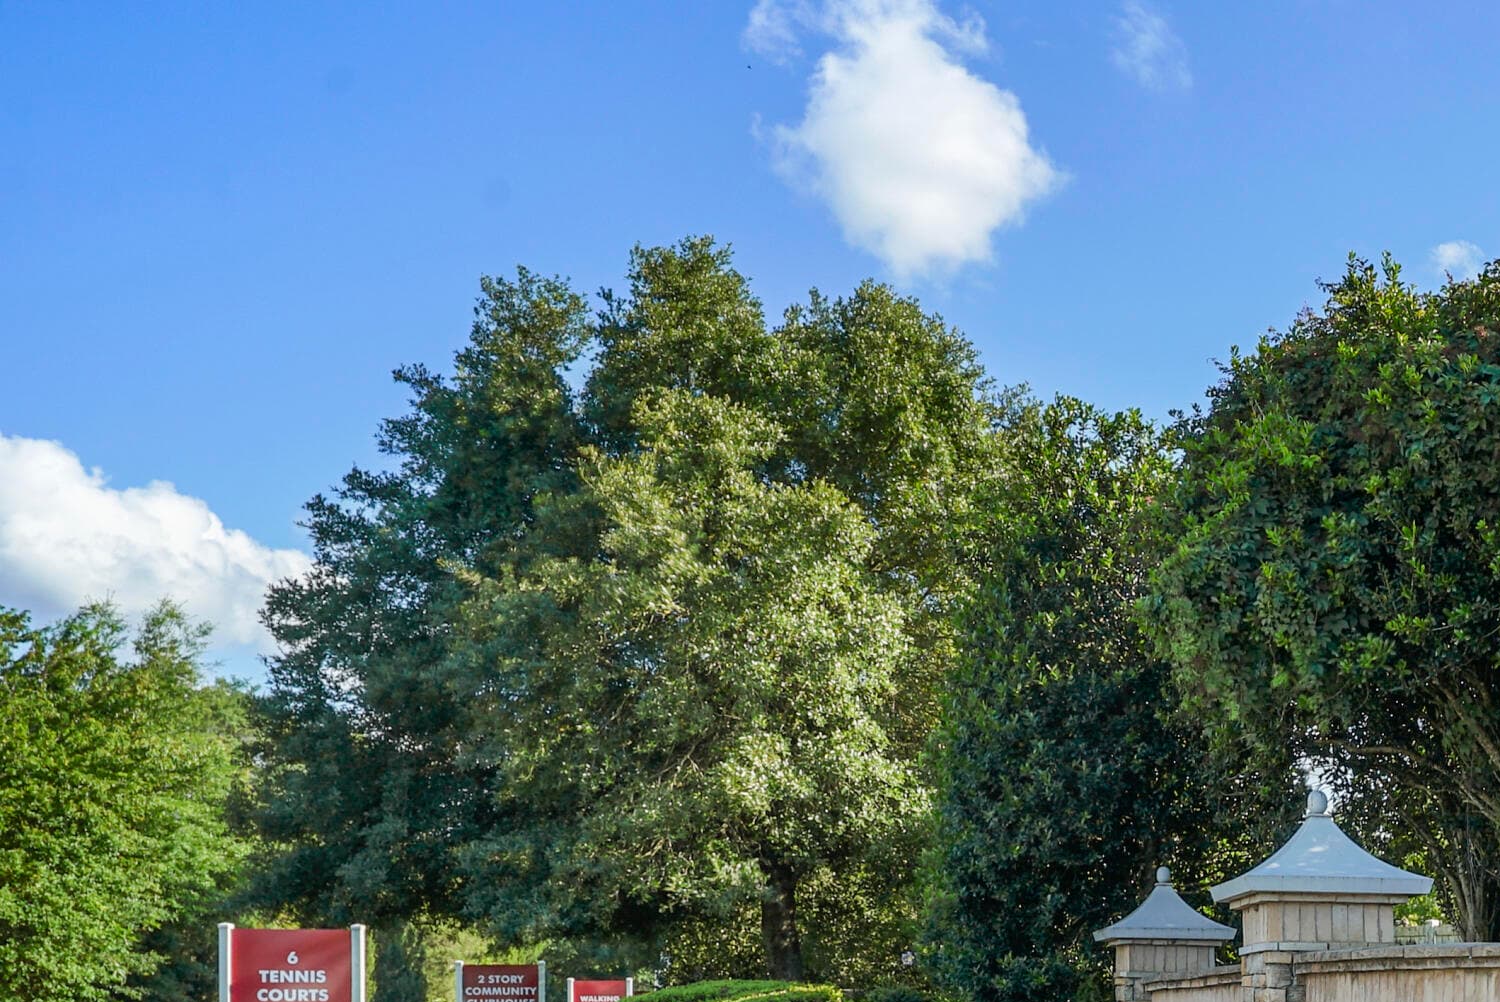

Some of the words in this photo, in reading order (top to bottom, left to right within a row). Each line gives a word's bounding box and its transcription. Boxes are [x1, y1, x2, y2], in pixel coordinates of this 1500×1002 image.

[287, 951, 299, 965] 6
[259, 969, 327, 984] TENNIS
[477, 975, 485, 984] 2
[488, 975, 525, 984] STORY
[256, 988, 329, 1002] COURTS
[465, 986, 537, 997] COMMUNITY
[579, 995, 620, 1002] WALKING
